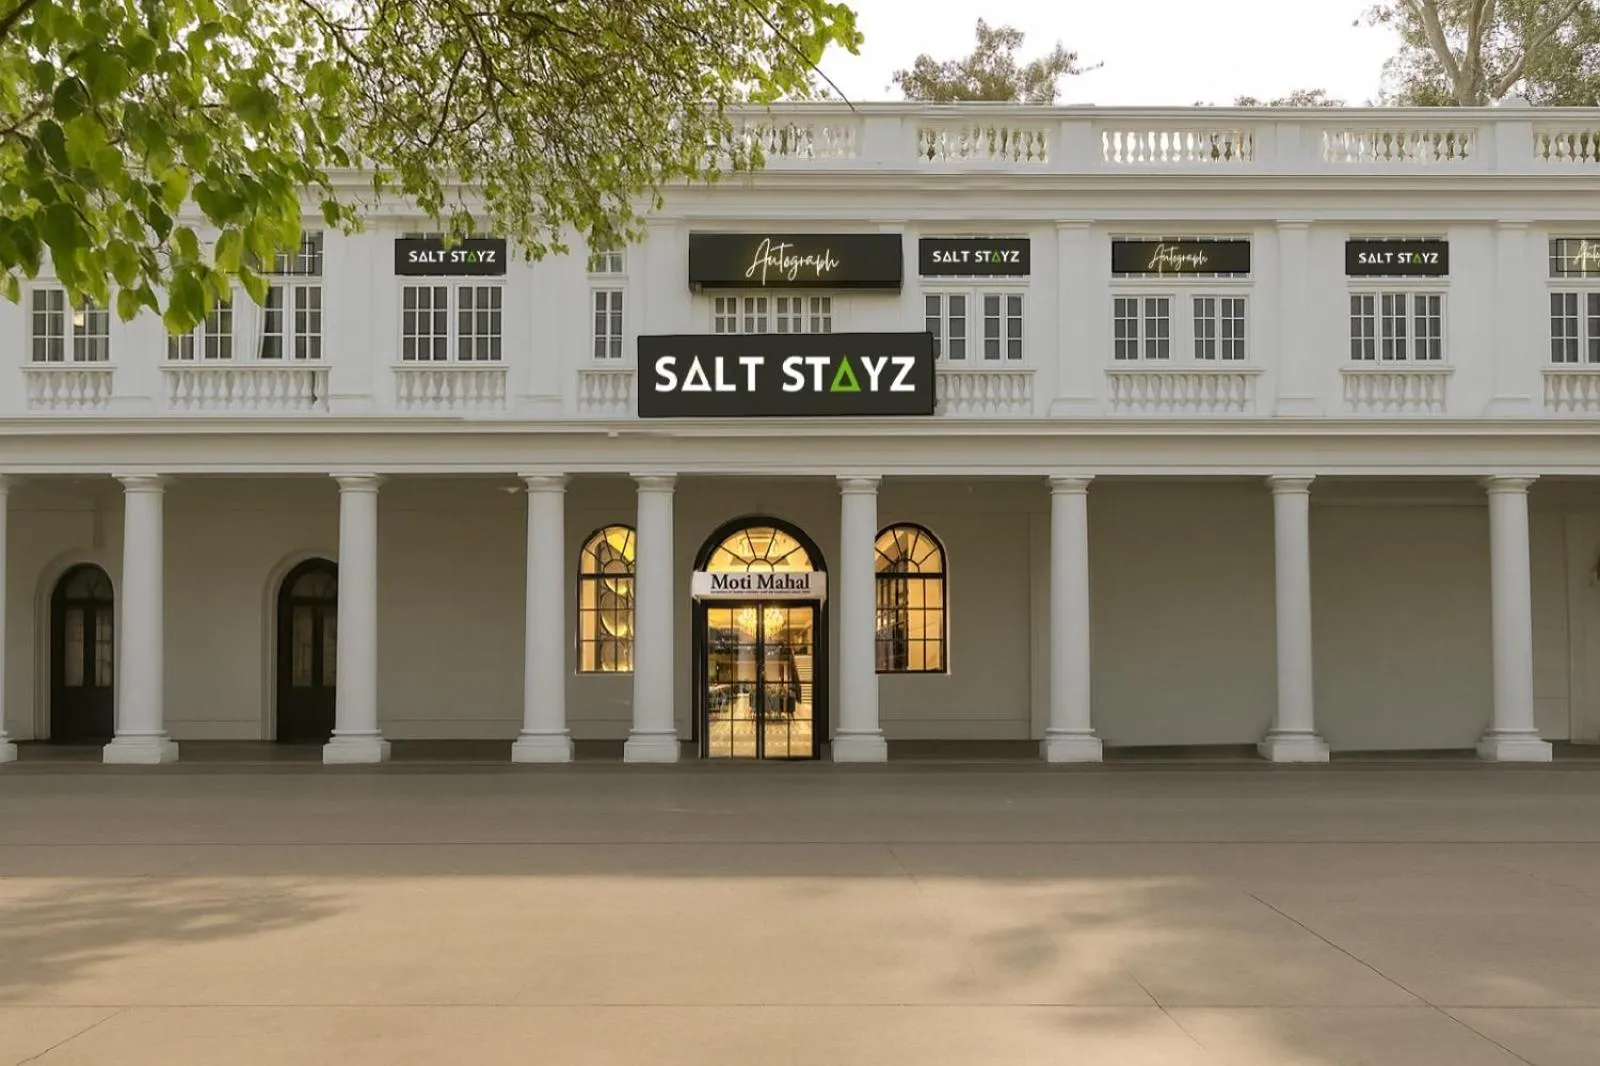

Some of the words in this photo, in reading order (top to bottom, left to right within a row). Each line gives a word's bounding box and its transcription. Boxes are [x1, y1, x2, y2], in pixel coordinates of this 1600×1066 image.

[408, 250, 447, 263] SALT
[451, 250, 496, 263] STAYZ
[746, 238, 840, 286] Autograph
[932, 250, 971, 263] SALT
[975, 250, 1020, 263] STAYZ
[1148, 243, 1209, 272] Autograph
[1358, 252, 1394, 264] SALT
[1398, 252, 1439, 264] STAYZ
[655, 355, 765, 393] SALT
[782, 355, 916, 393] STAYZ
[711, 574, 752, 589] Moti
[758, 574, 810, 589] Mahal
